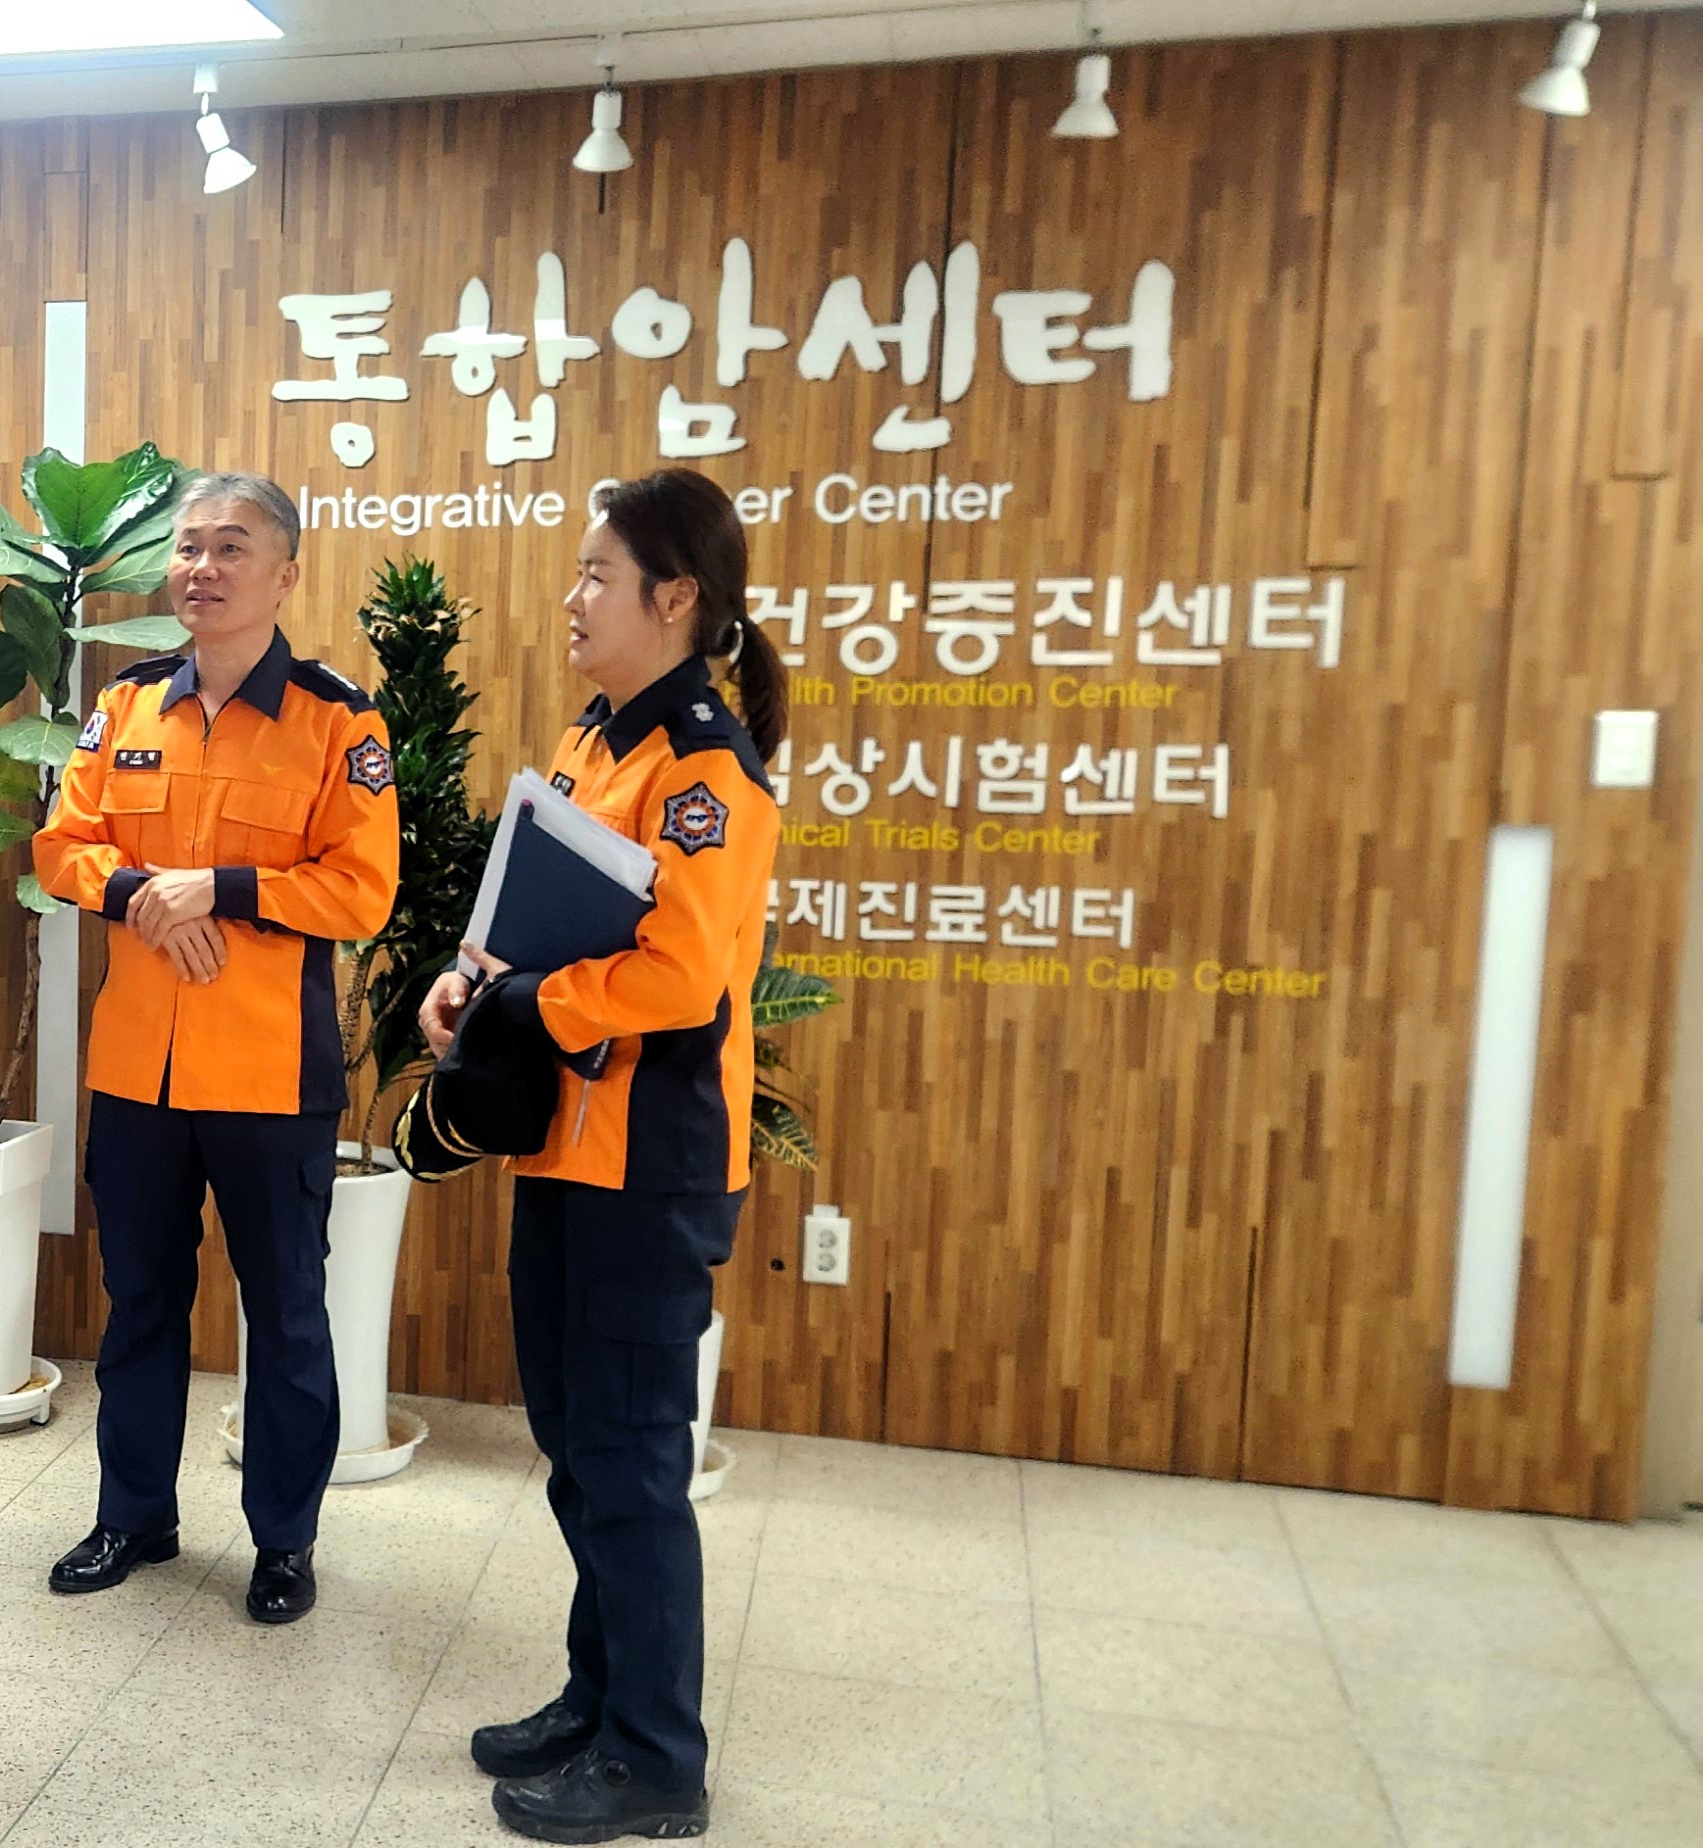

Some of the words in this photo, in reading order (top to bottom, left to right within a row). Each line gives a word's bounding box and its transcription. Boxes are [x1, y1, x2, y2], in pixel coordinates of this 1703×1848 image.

[271, 237, 1174, 468] 통합암센터
[299, 480, 566, 538] Integrative
[814, 473, 1015, 524] Center
[744, 575, 1346, 676] 건강증진센터
[850, 675, 1034, 708] Promotion
[1048, 675, 1179, 709] Center
[865, 817, 960, 852] Trials
[973, 820, 1101, 855] Center
[953, 953, 1071, 987] Health
[1085, 957, 1178, 991] Care
[1193, 960, 1325, 996] Center
